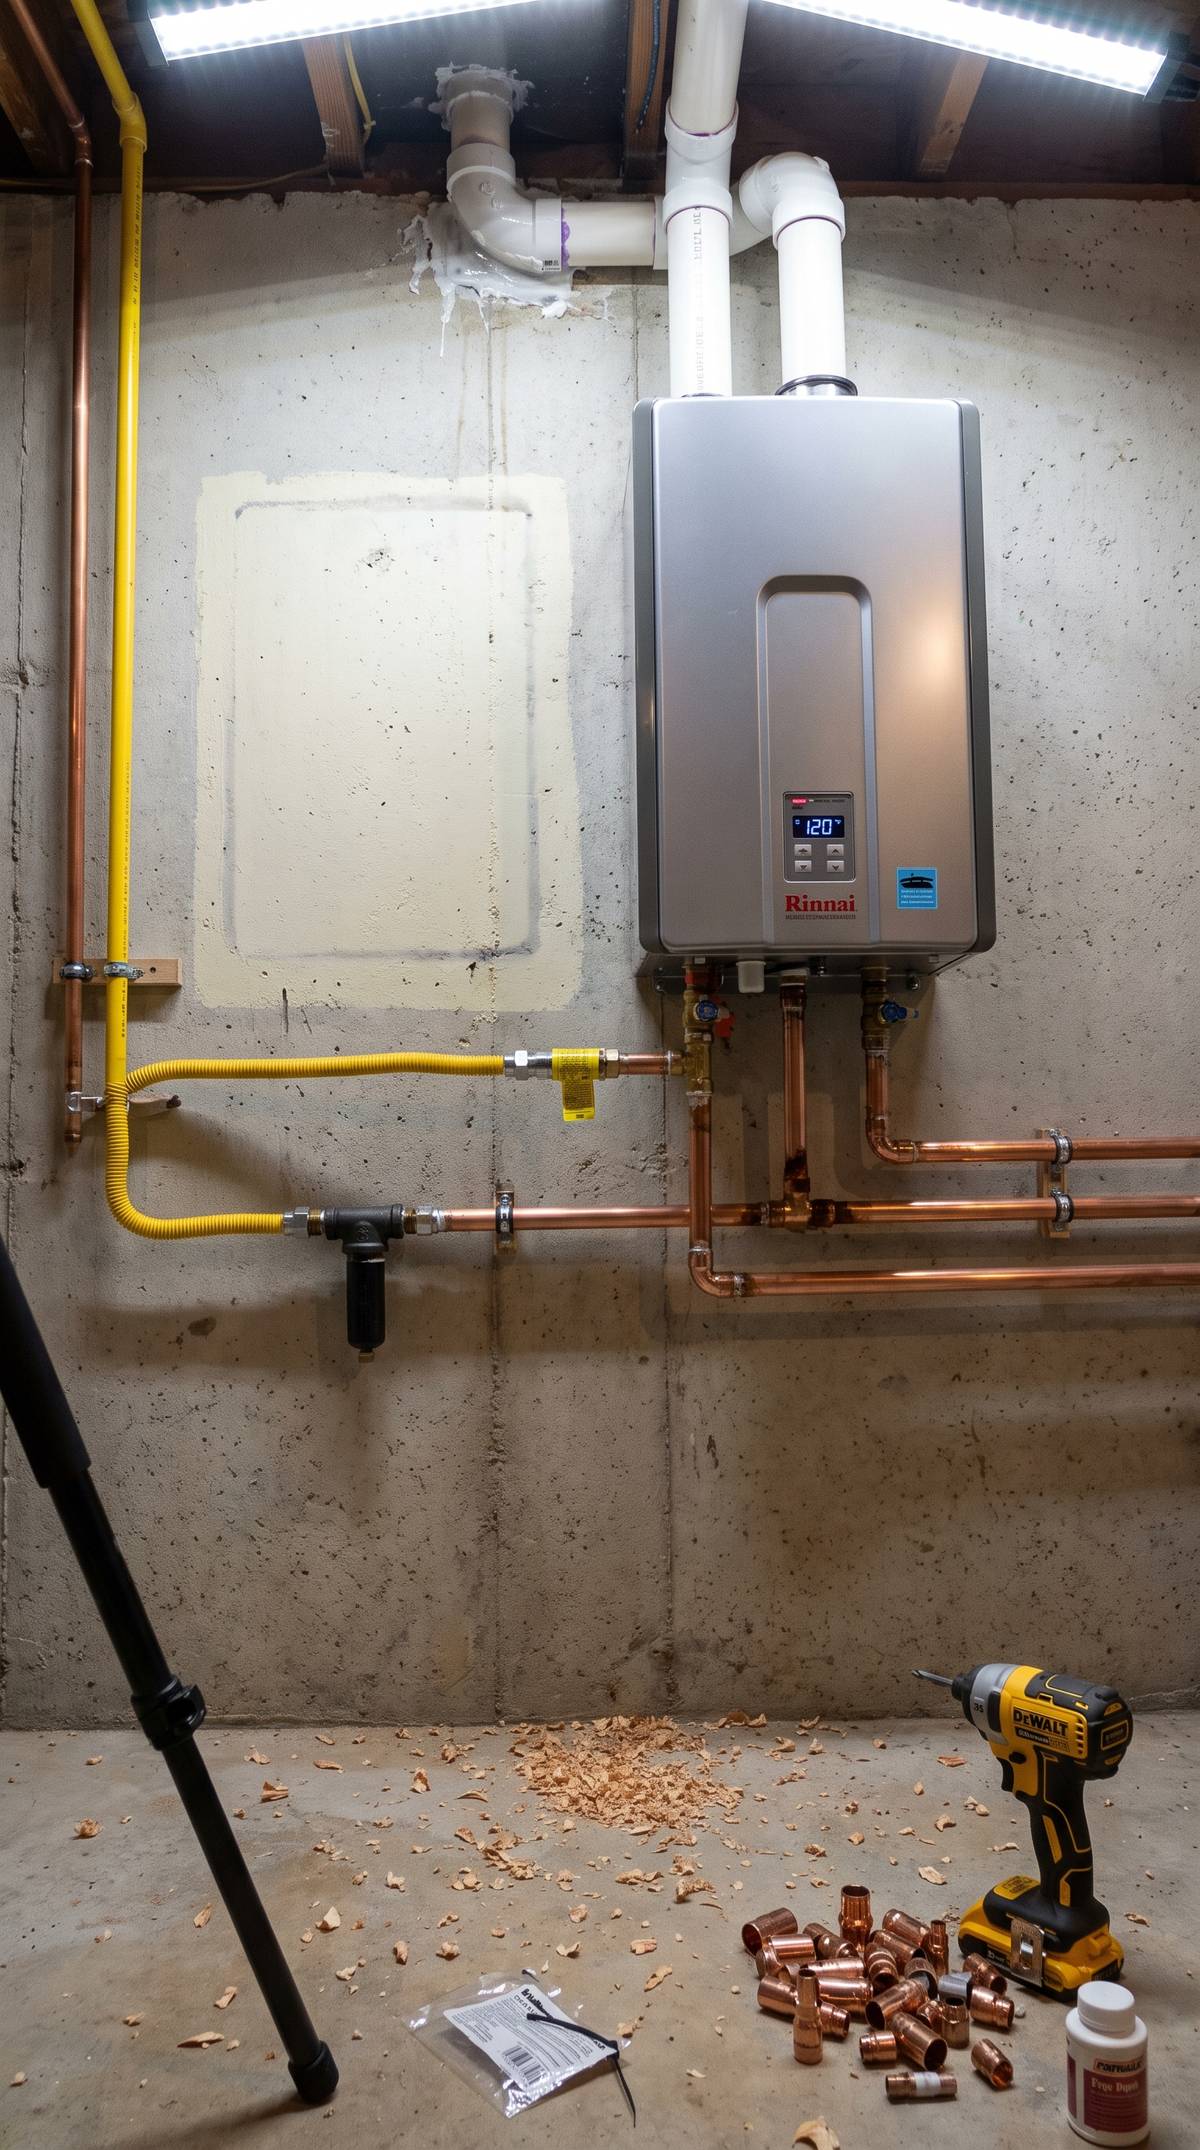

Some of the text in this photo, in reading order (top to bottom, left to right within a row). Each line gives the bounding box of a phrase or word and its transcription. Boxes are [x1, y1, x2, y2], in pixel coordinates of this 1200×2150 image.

[806, 818, 833, 835] 120
[785, 894, 855, 912] Rinnai
[1012, 1707, 1069, 1737] DEWALT
